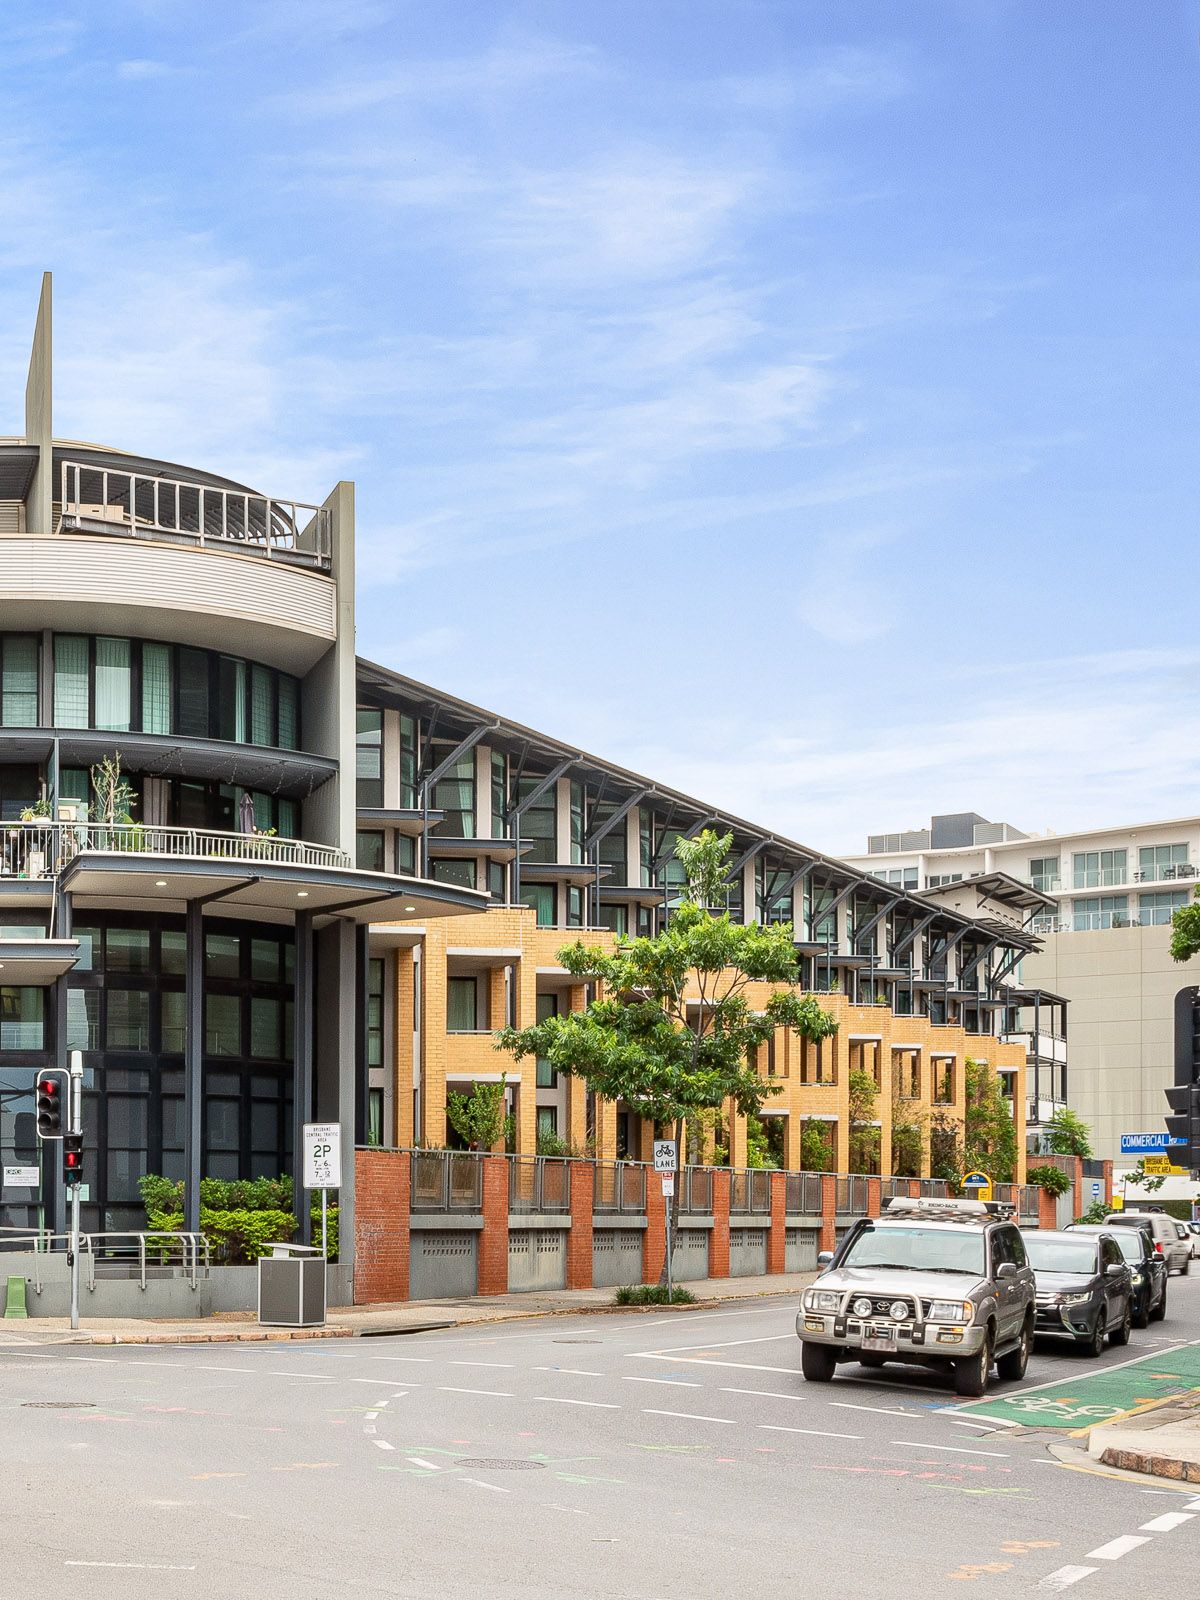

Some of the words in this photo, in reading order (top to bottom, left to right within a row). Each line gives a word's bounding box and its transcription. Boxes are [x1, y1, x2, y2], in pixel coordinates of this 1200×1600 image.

[1122, 1134, 1165, 1147] COMMERCIAL
[313, 1144, 332, 1158] 2P
[655, 1159, 675, 1168] LANE
[1161, 1165, 1171, 1174] AREA
